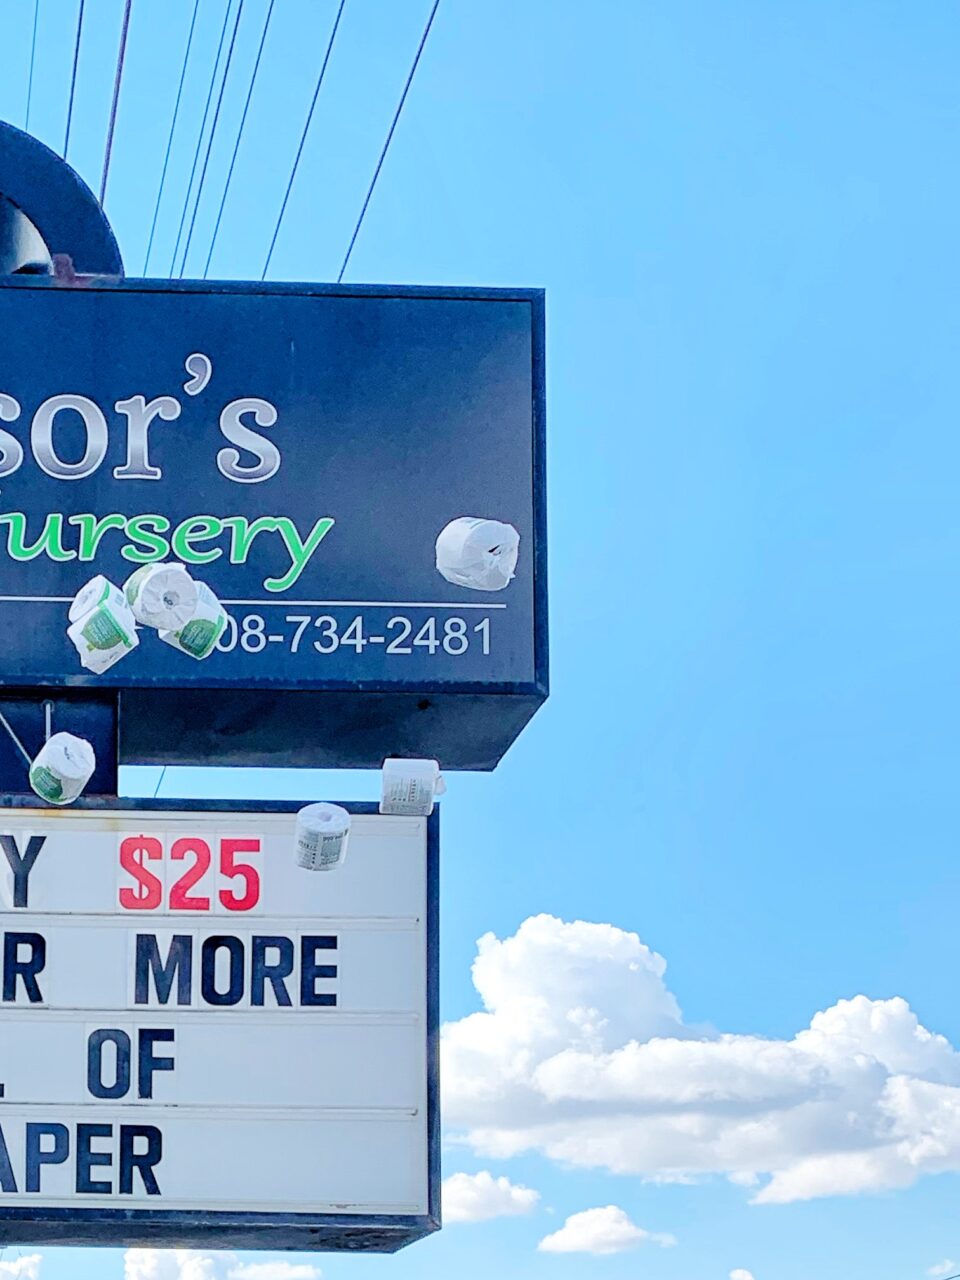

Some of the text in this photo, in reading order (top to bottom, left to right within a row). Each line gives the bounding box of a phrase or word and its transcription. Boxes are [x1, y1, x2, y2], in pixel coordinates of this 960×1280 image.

[215, 614, 492, 656] 08-734-2481
[118, 834, 261, 911] $25
[134, 933, 338, 1007] MORE
[87, 1027, 175, 1100] OF
